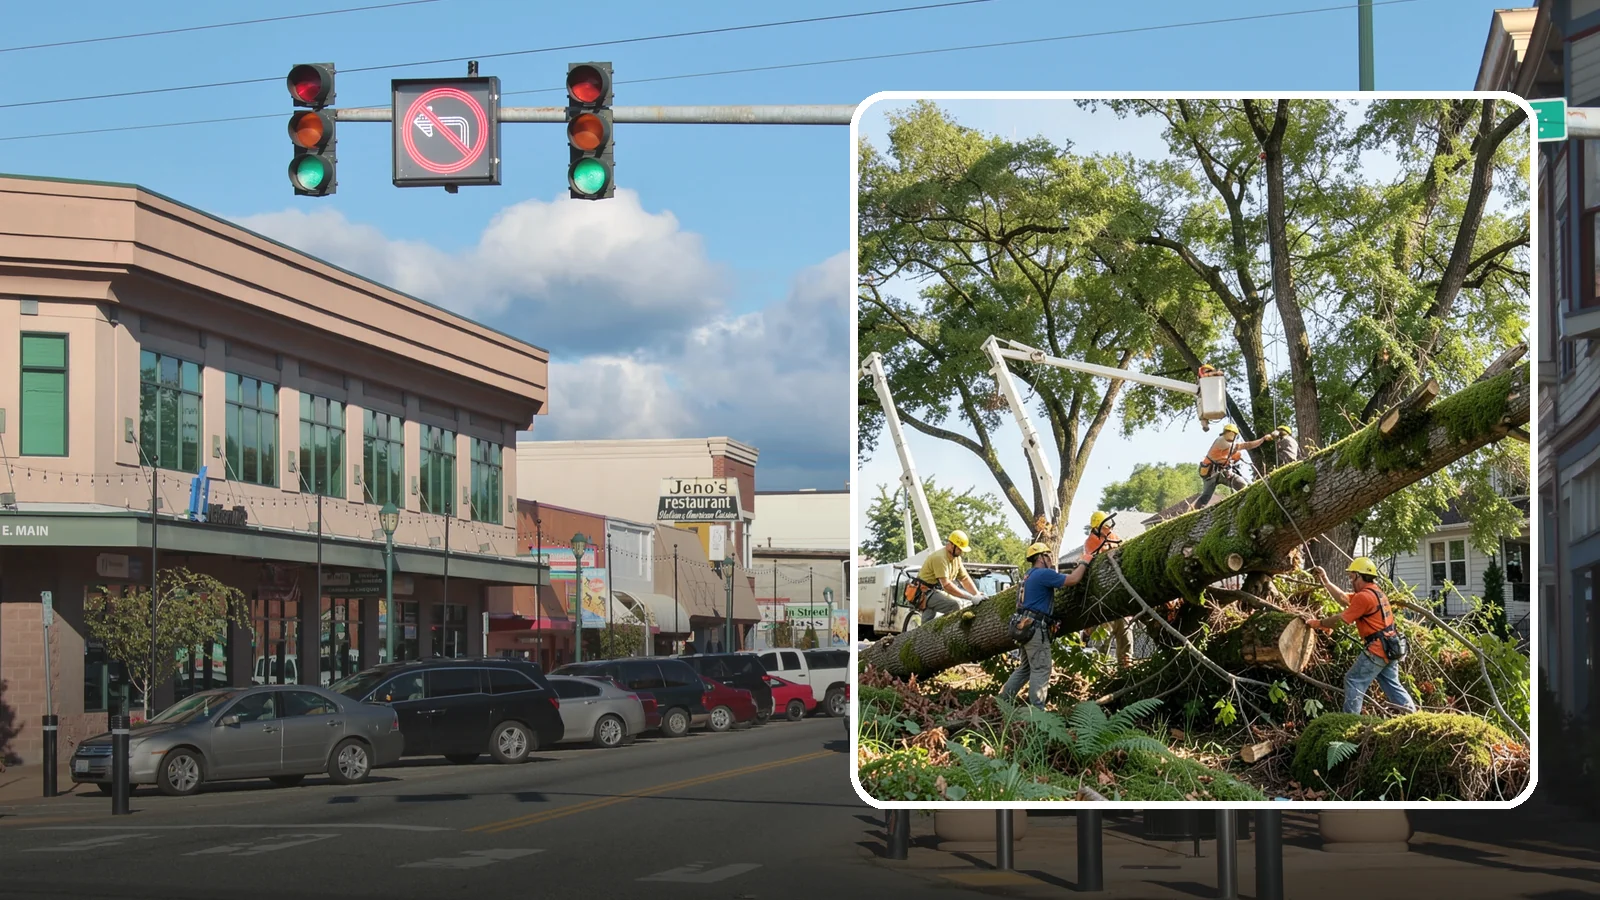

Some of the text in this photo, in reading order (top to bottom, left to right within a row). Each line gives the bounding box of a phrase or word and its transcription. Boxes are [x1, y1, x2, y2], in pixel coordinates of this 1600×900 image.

[670, 480, 727, 494] Jeno's
[665, 496, 731, 509] restaurant
[686, 510, 715, 519] American
[715, 510, 738, 519] Cuisine
[2, 525, 49, 536] E. MAIN
[797, 608, 828, 616] Street
